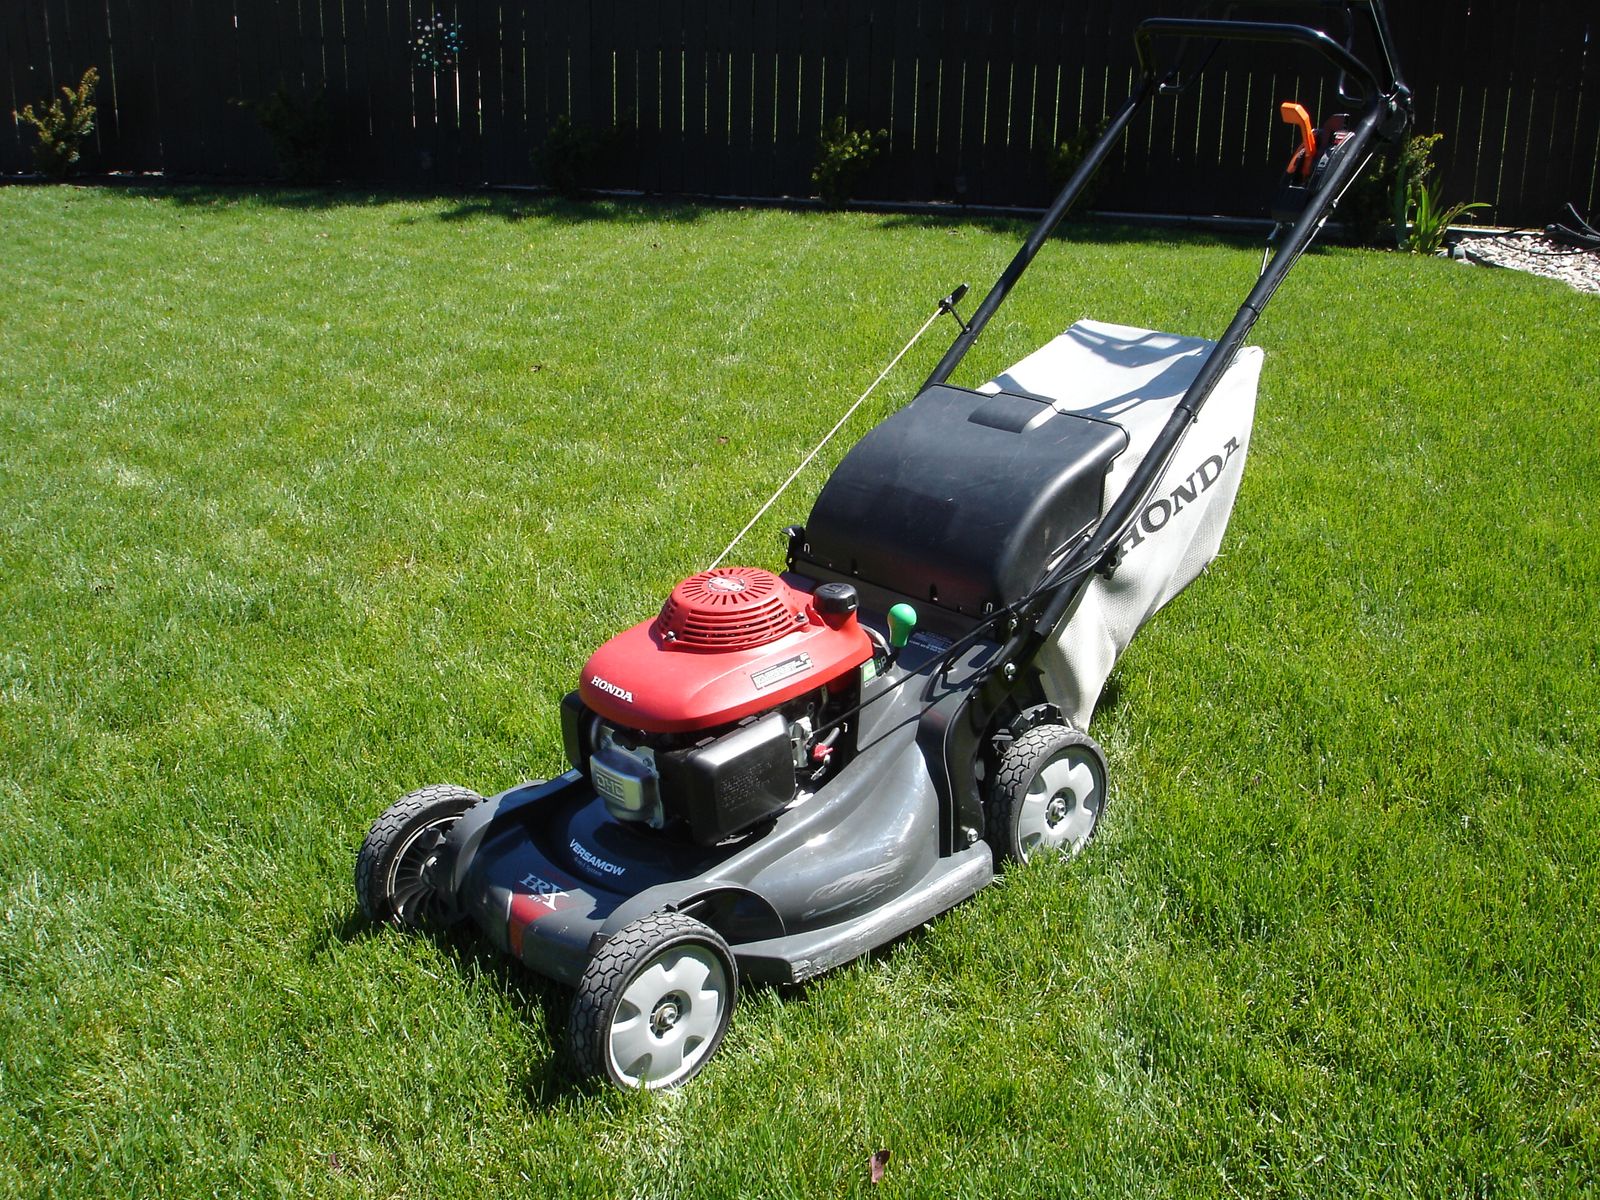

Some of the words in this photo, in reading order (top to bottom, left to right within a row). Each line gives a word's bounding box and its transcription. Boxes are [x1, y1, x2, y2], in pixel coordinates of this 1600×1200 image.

[1119, 436, 1240, 559] HONDA
[591, 675, 633, 703] HONDA
[569, 838, 626, 876] VERSAMOW
[519, 873, 570, 911] HRX
